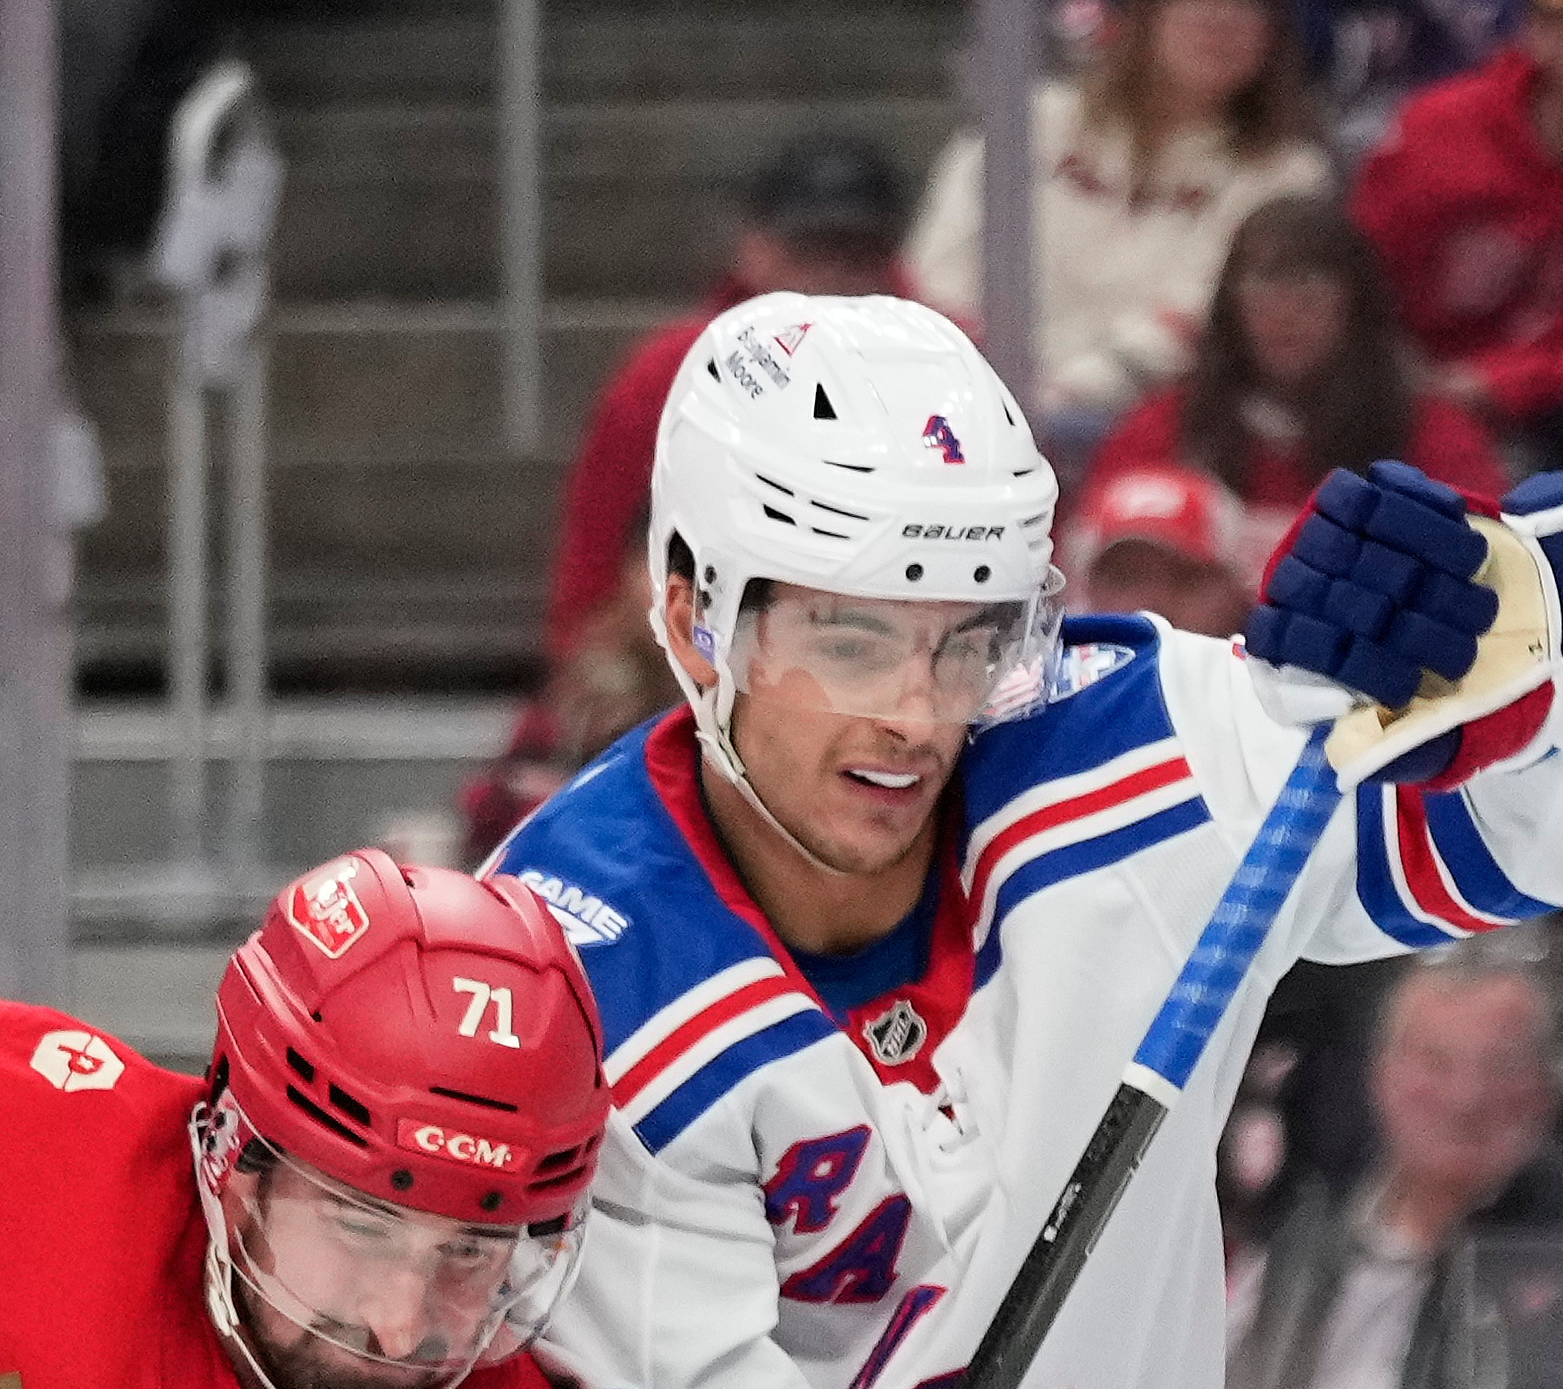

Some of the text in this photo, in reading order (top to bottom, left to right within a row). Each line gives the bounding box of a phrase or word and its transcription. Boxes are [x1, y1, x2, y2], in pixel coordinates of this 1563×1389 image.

[923, 414, 965, 464] 4
[902, 523, 1005, 542] BAUER
[452, 976, 521, 1049] 71
[413, 1124, 514, 1169] CCM
